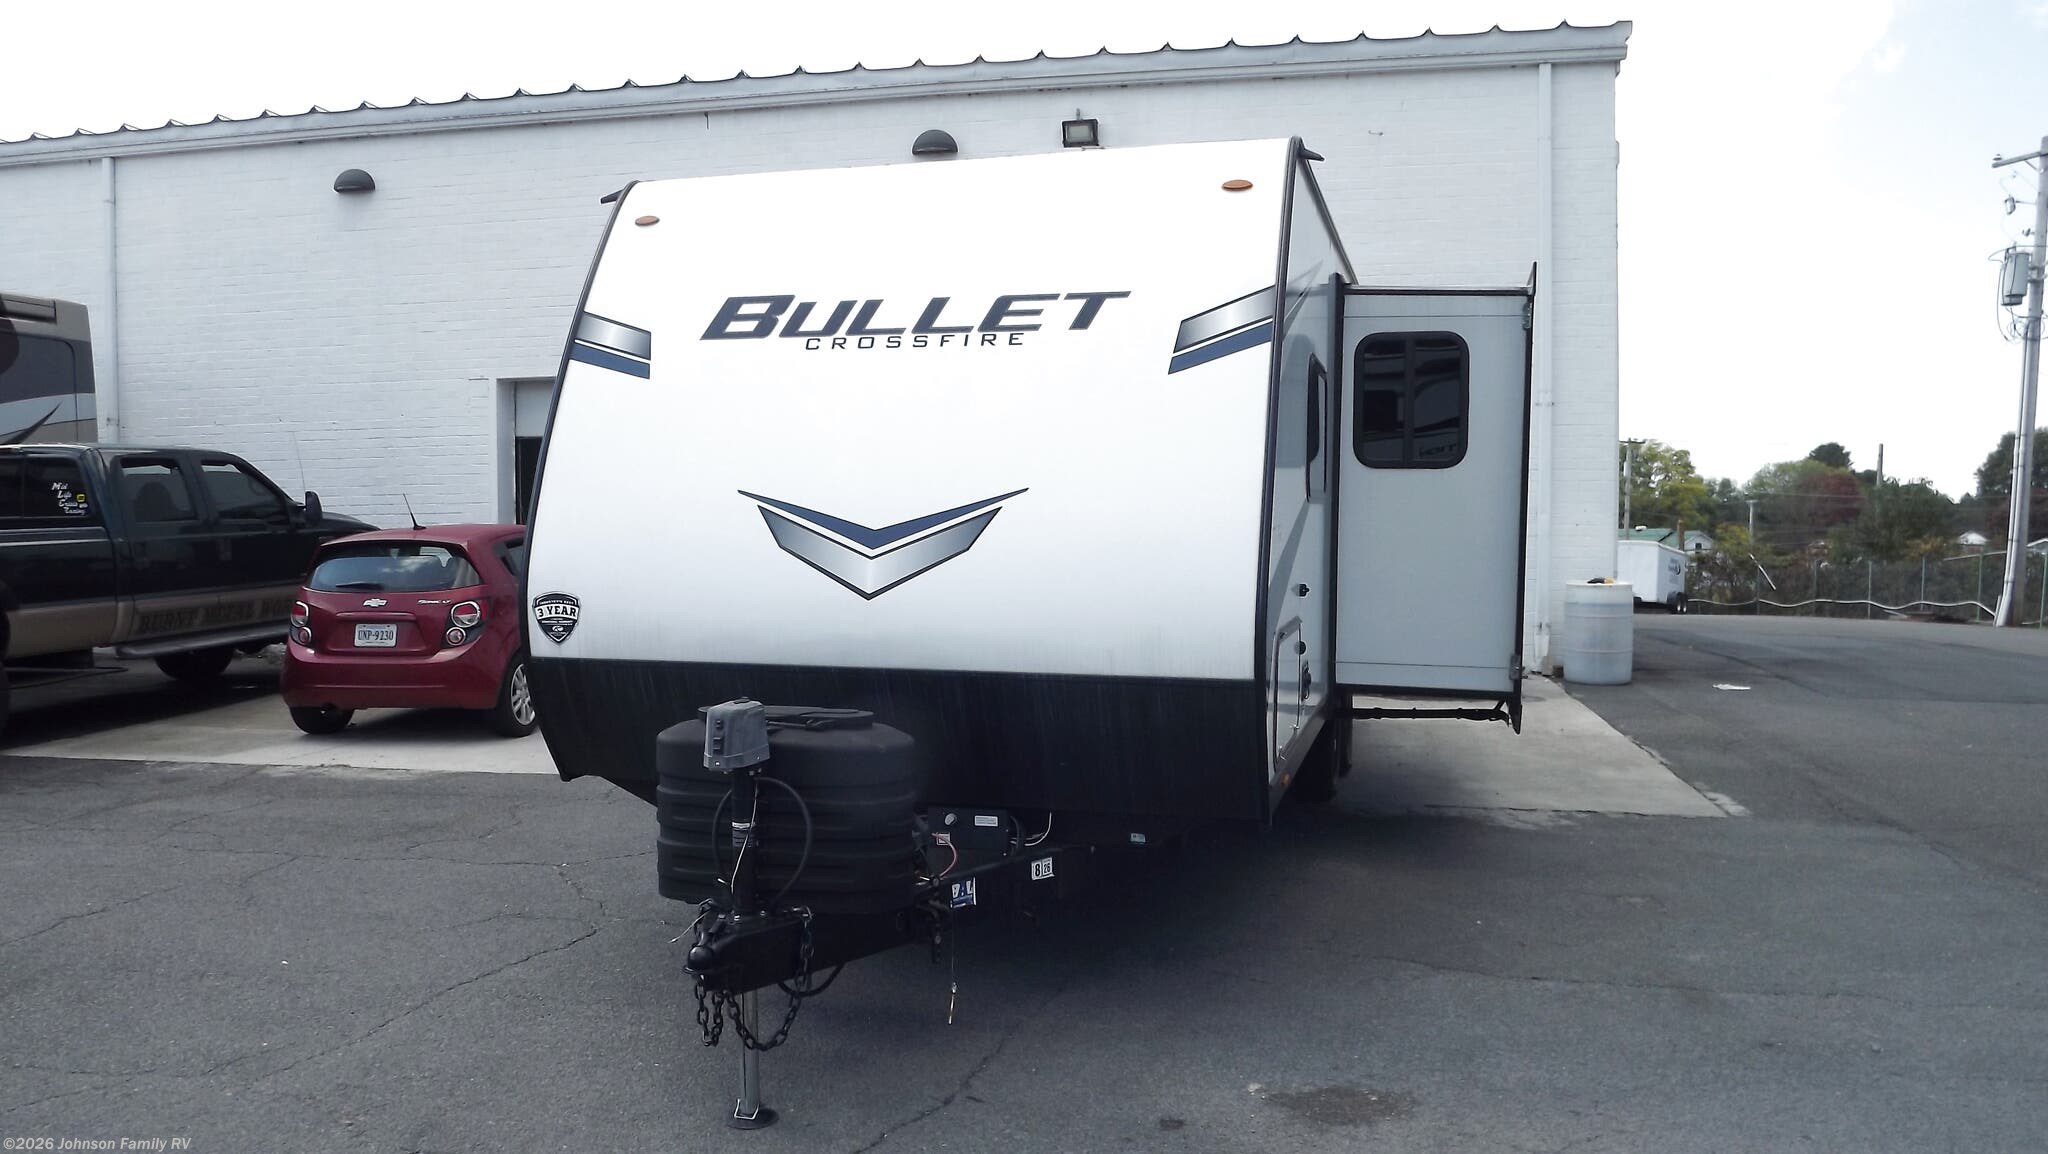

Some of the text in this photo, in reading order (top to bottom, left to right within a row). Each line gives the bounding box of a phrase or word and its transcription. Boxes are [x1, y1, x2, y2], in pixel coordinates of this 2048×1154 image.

[700, 290, 1132, 340] BULLET
[804, 332, 1025, 351] CROSSFIRE
[537, 605, 577, 617] 3 YEAR
[1035, 863, 1041, 877] 8
